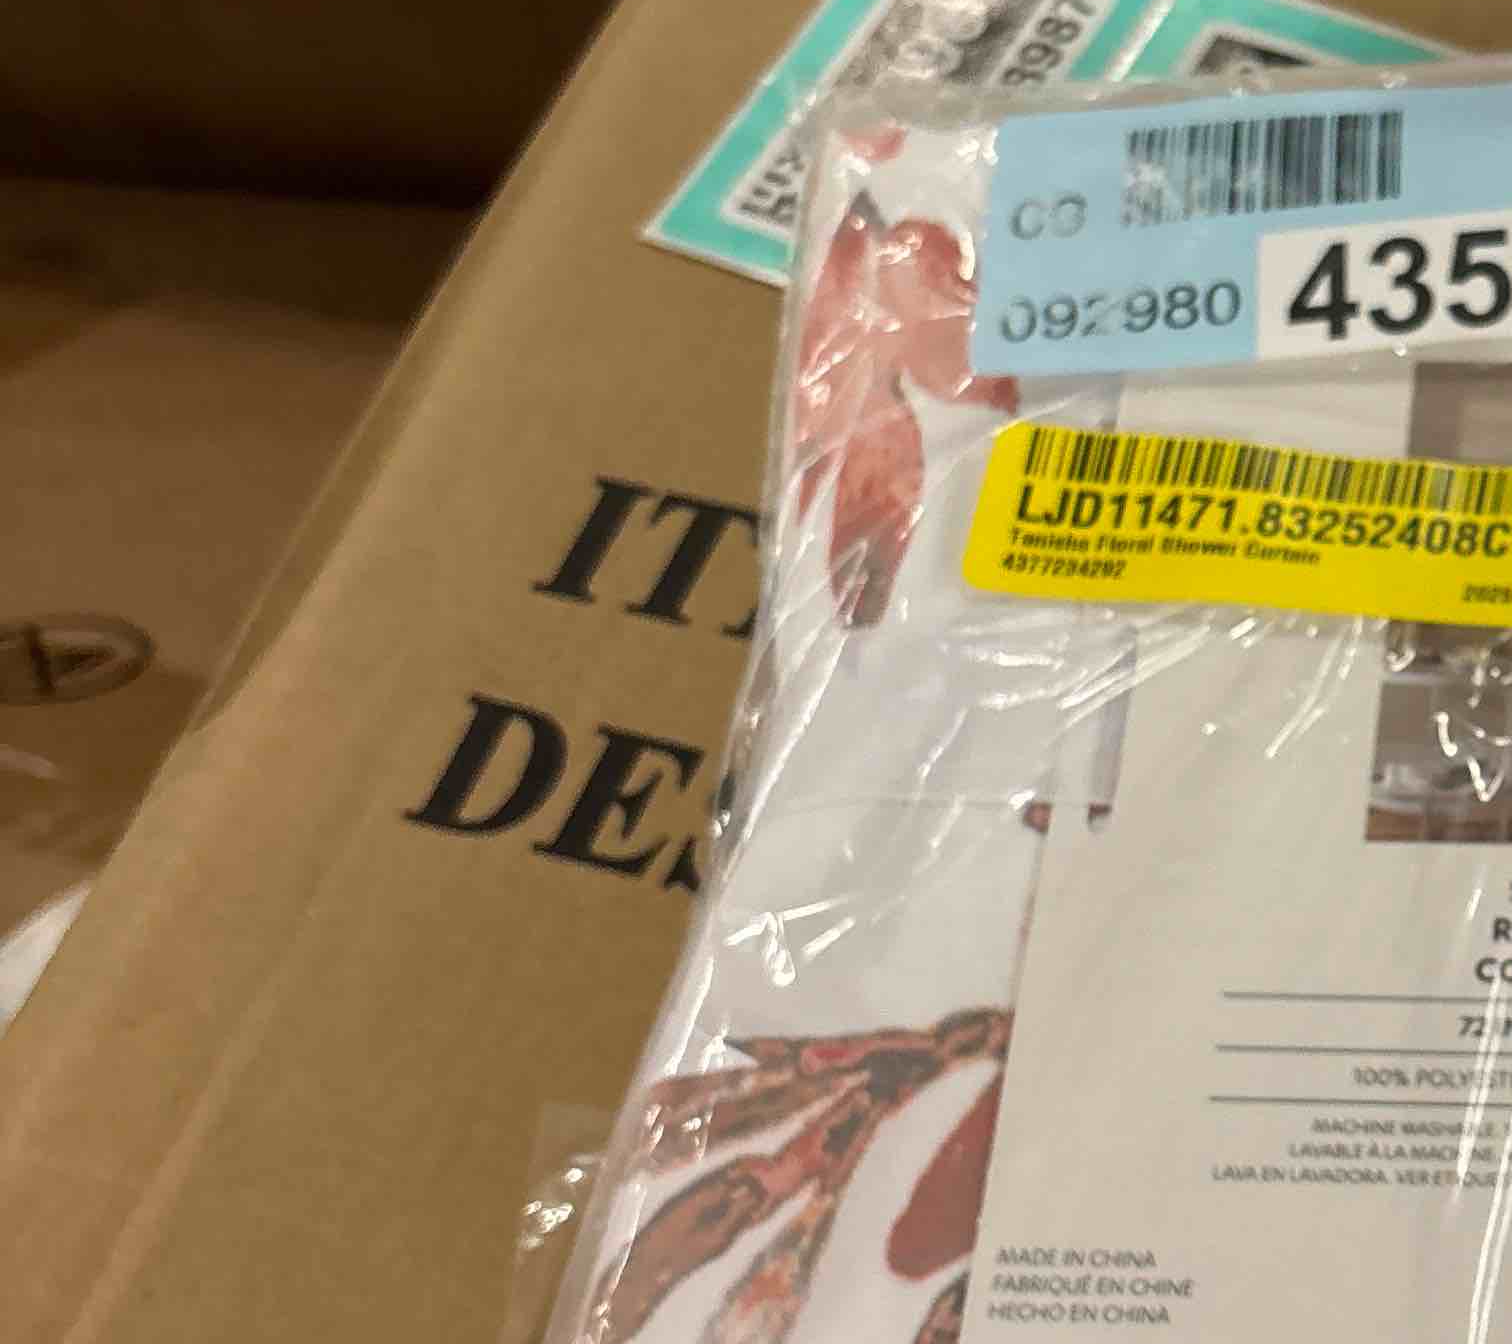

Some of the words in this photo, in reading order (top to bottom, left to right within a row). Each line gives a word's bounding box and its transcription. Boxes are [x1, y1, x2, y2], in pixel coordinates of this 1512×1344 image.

[1016, 482, 1512, 558] LJD11471.83252408C
[530, 474, 765, 642] IT
[1161, 536, 1237, 558] Shower
[1458, 1015, 1485, 1037] 72
[1354, 1067, 1408, 1087] 100%
[995, 1246, 1057, 1267] MADE
[1063, 1248, 1085, 1267] IN
[1090, 1249, 1157, 1269] CHINA
[1098, 1275, 1125, 1295] EN
[1129, 1277, 1195, 1298] CHINE
[987, 1302, 1067, 1323] HECHO
[1069, 1304, 1097, 1324] EN
[1102, 1305, 1171, 1325] CHINA
